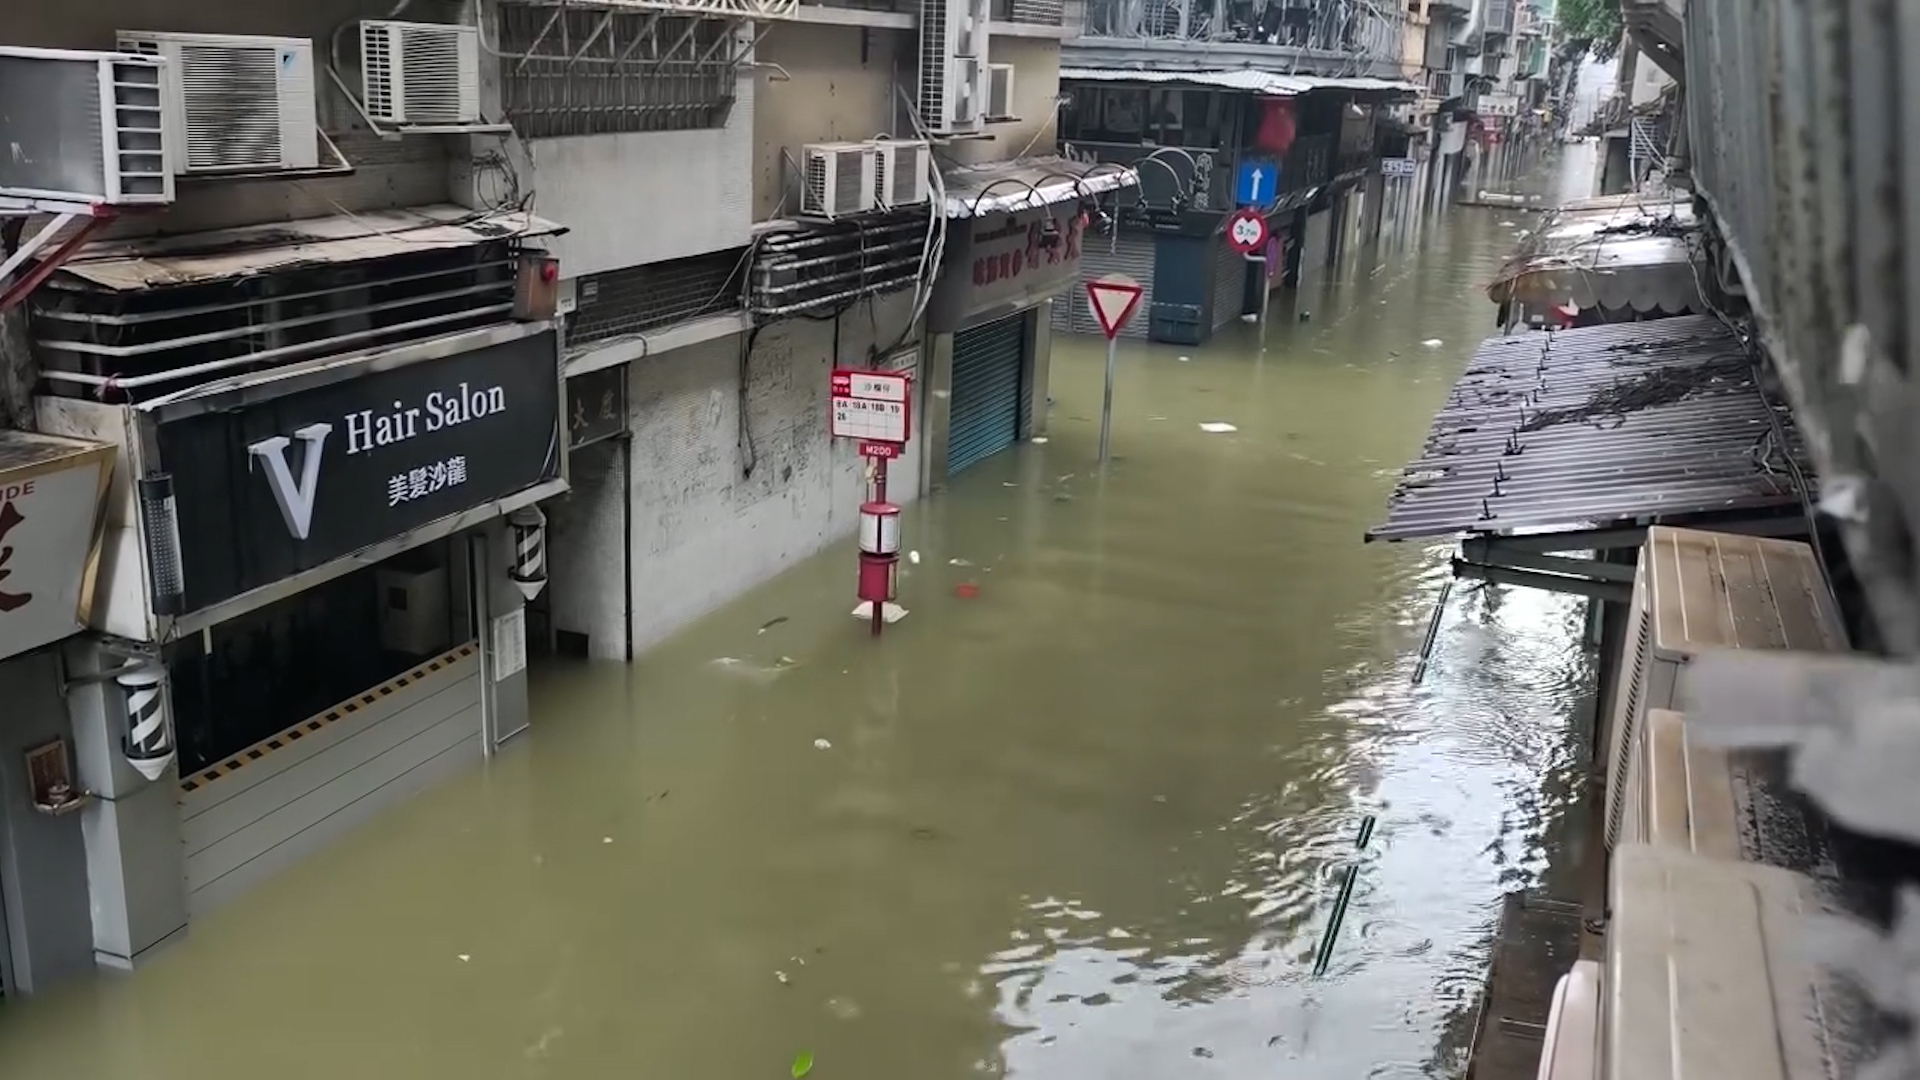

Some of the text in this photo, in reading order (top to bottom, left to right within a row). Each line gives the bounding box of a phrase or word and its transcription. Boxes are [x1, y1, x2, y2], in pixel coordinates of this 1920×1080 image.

[344, 382, 506, 454] Hair Salon
[865, 445, 892, 456] M200
[247, 423, 333, 540] V
[388, 456, 467, 507] 美髮沙龍
